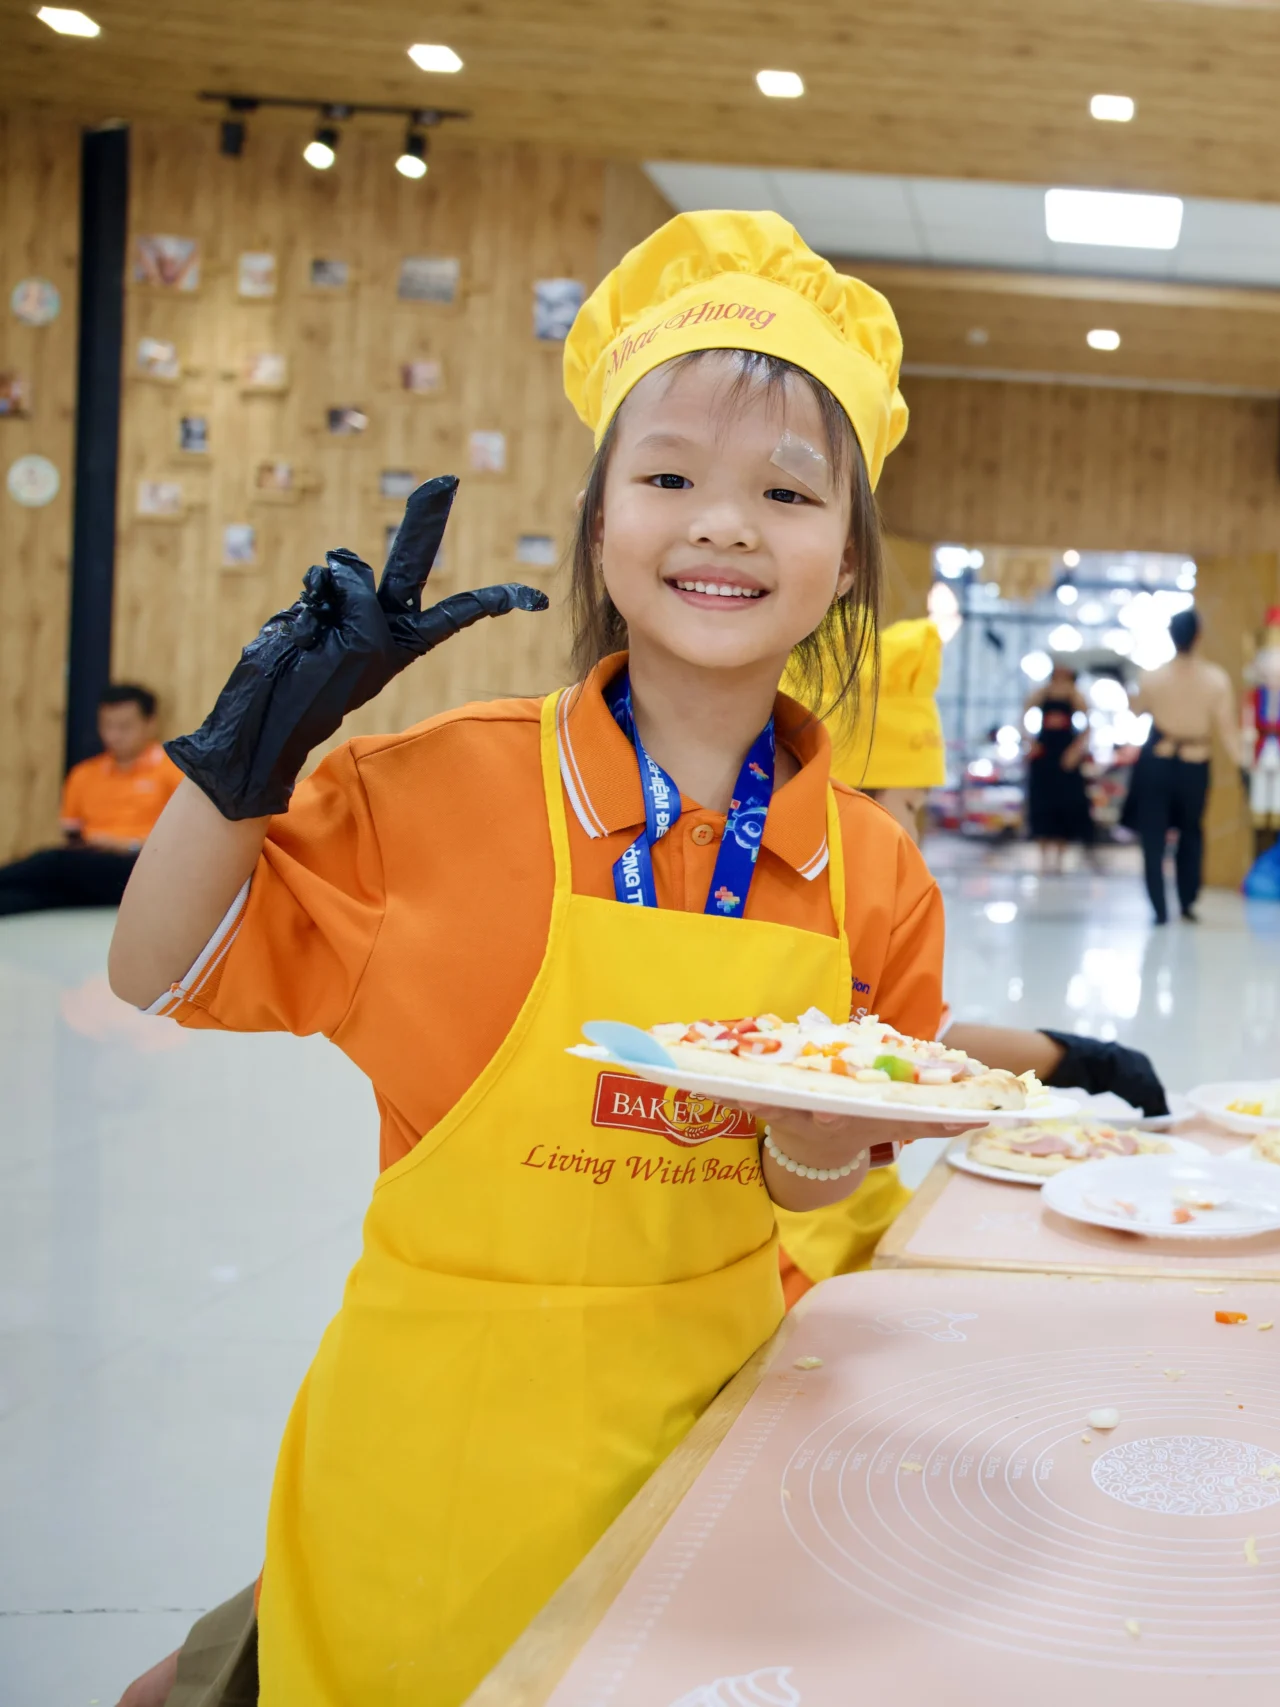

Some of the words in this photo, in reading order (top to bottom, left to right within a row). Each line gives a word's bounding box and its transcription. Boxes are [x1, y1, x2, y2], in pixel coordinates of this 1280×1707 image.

[611, 1092, 704, 1125] BAKER
[520, 1144, 616, 1184] Living
[625, 1156, 696, 1185] With
